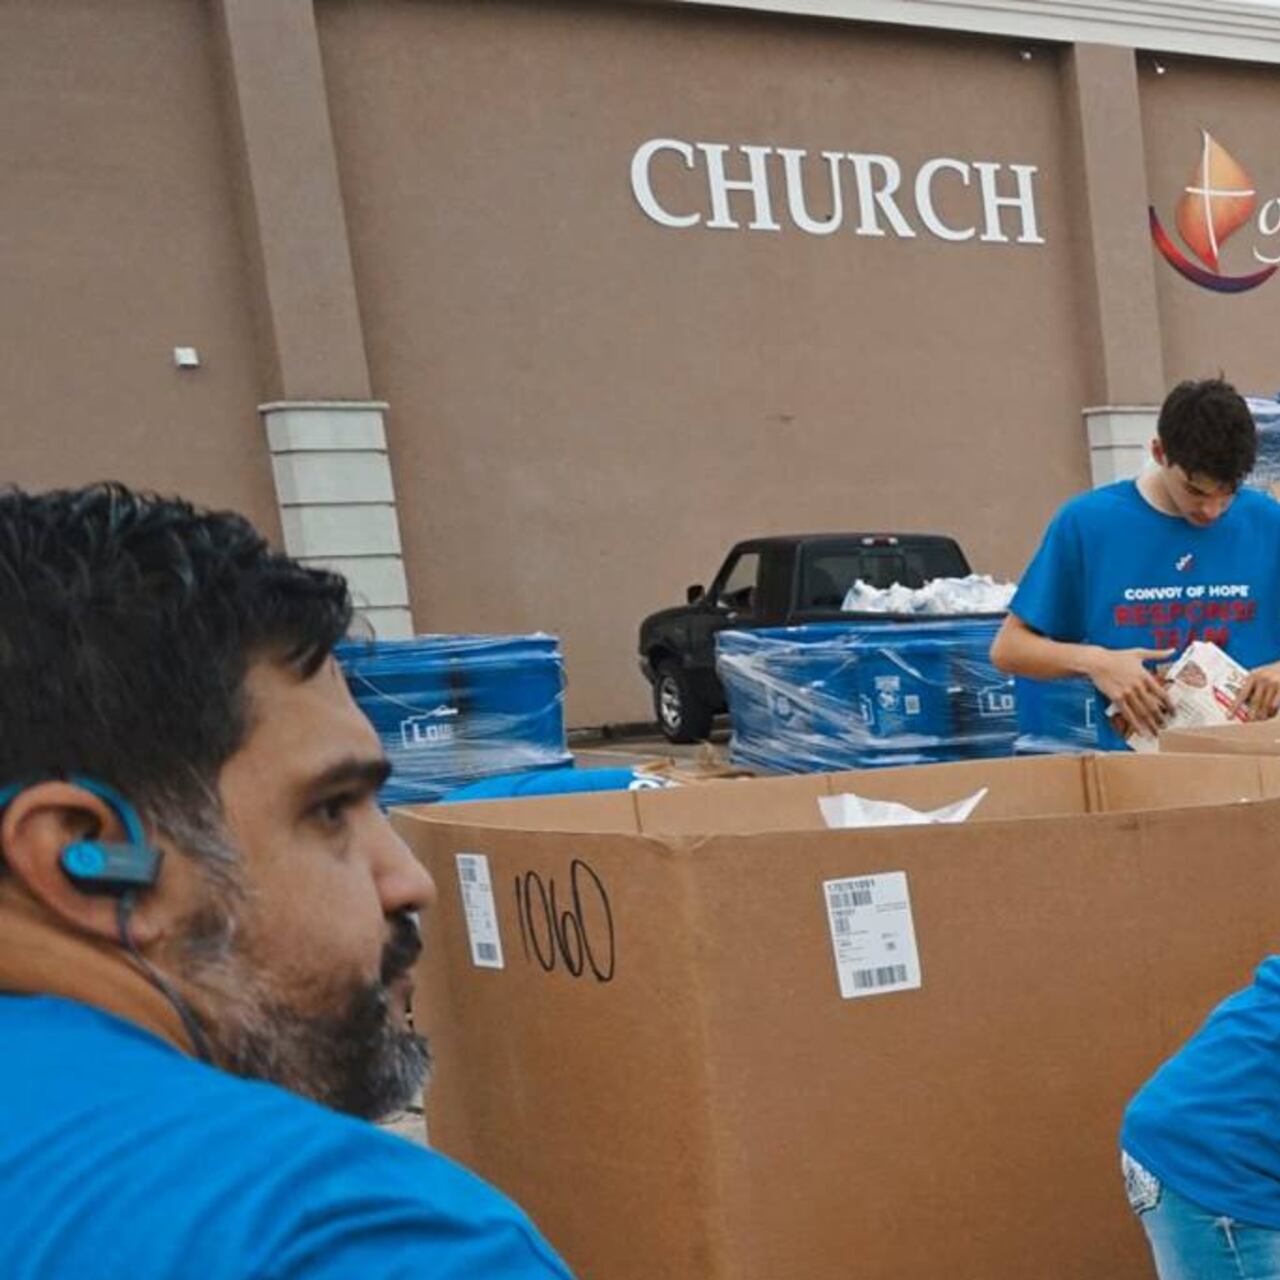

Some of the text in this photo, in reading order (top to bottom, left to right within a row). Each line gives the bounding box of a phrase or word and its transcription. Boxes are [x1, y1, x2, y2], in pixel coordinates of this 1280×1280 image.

[630, 137, 1045, 245] CHURCH
[1115, 601, 1257, 626] RESPONSE
[1124, 585, 1250, 600] CONVOY OF HOPE
[515, 859, 614, 981] 1060
